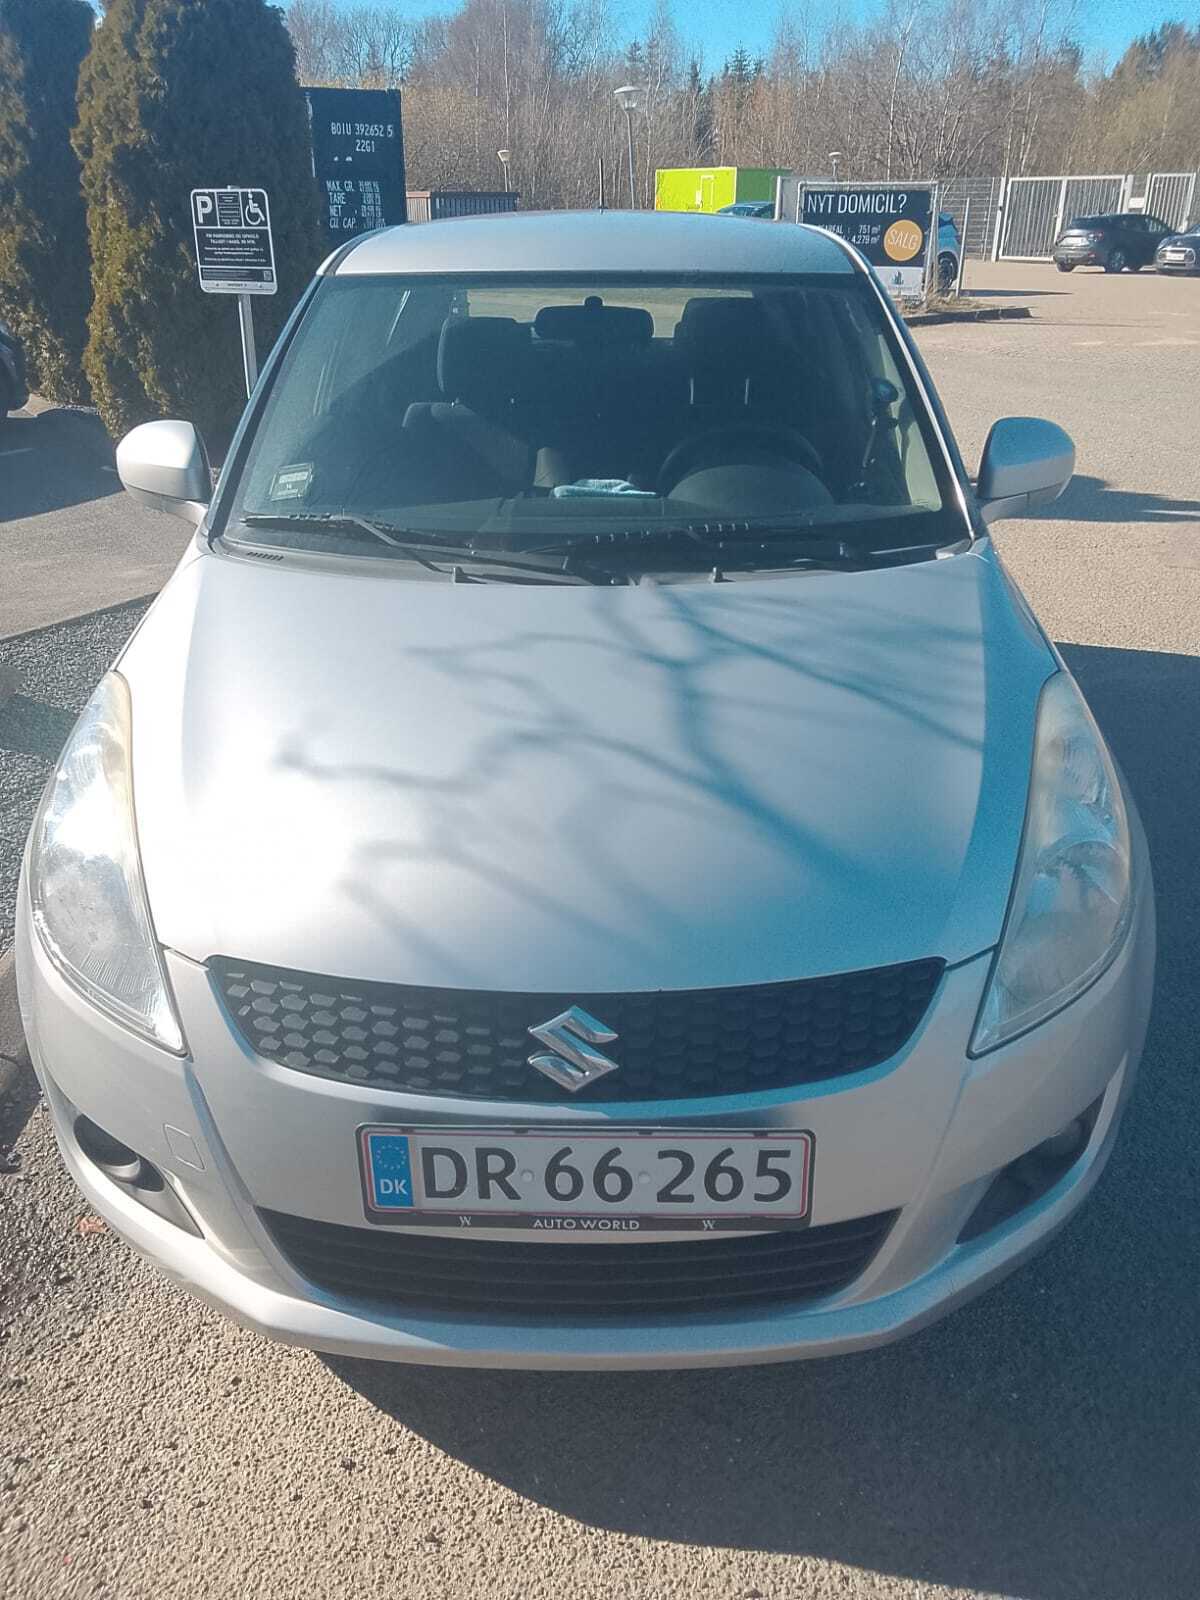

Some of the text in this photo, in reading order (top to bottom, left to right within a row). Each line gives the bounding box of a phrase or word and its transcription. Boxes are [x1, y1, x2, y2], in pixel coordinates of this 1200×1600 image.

[355, 123, 384, 137] 392652
[329, 192, 346, 204] TARE
[807, 194, 907, 213] NYT DOMICIL?
[196, 195, 213, 224] P
[329, 204, 342, 216] NET
[888, 229, 918, 250] SALG
[421, 1146, 792, 1203] DR 66 265
[380, 1178, 408, 1195] DK
[533, 1218, 640, 1230] AUTO WORLD
